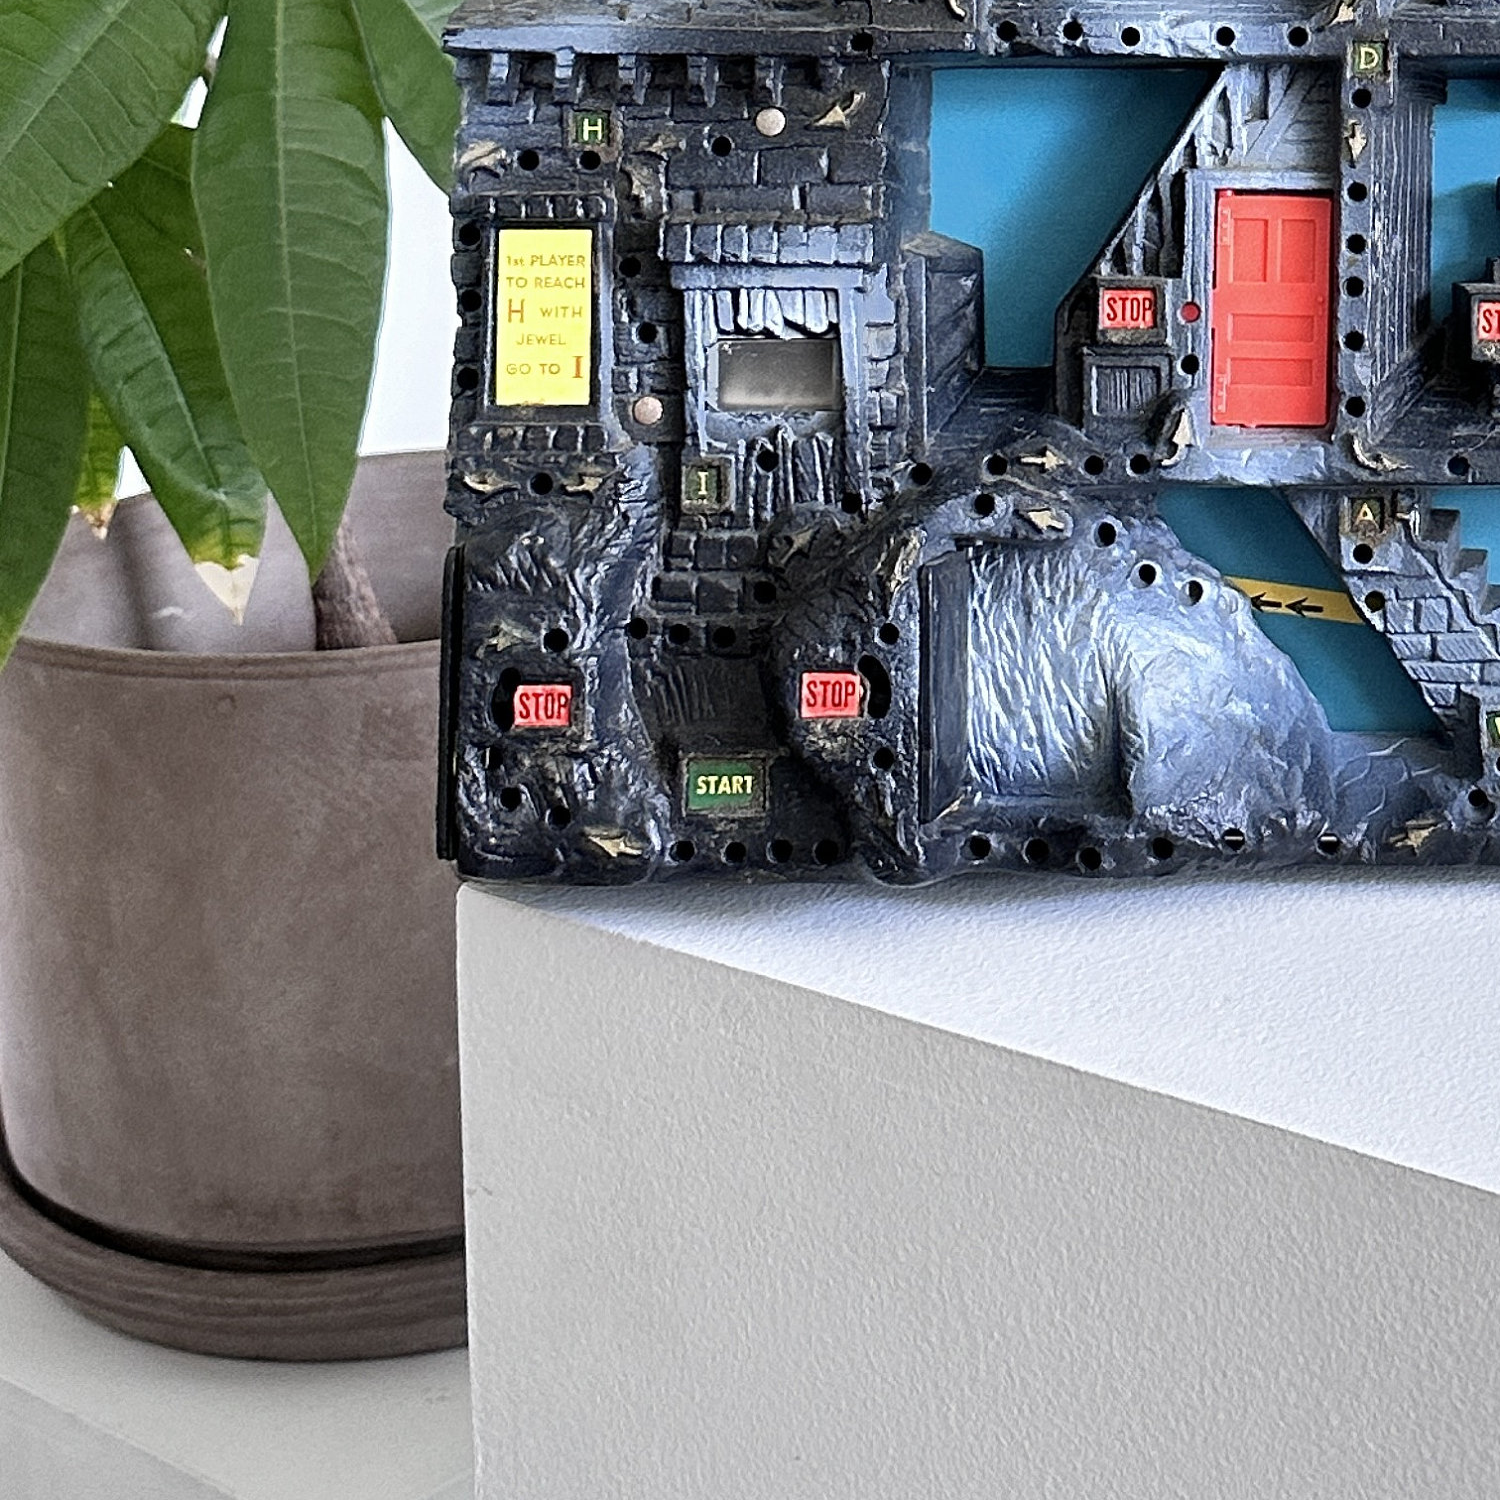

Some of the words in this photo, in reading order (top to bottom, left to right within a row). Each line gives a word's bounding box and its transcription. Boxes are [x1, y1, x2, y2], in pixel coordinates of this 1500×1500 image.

[1359, 44, 1380, 68] D
[583, 117, 602, 143] H
[507, 255, 524, 267] 1st
[530, 254, 586, 267] PLAYER
[506, 276, 528, 289] TO
[534, 277, 585, 290] REACH
[507, 298, 525, 323] H
[540, 306, 583, 319] WITH
[1107, 296, 1151, 322] STOP
[517, 333, 567, 346] JEWEL
[506, 363, 531, 375] GO
[539, 363, 561, 375] TO
[571, 355, 584, 379] I
[697, 471, 709, 496] I
[1354, 501, 1379, 528] A
[519, 692, 569, 719] STOP
[806, 680, 856, 708] STOP
[696, 775, 755, 795] START
